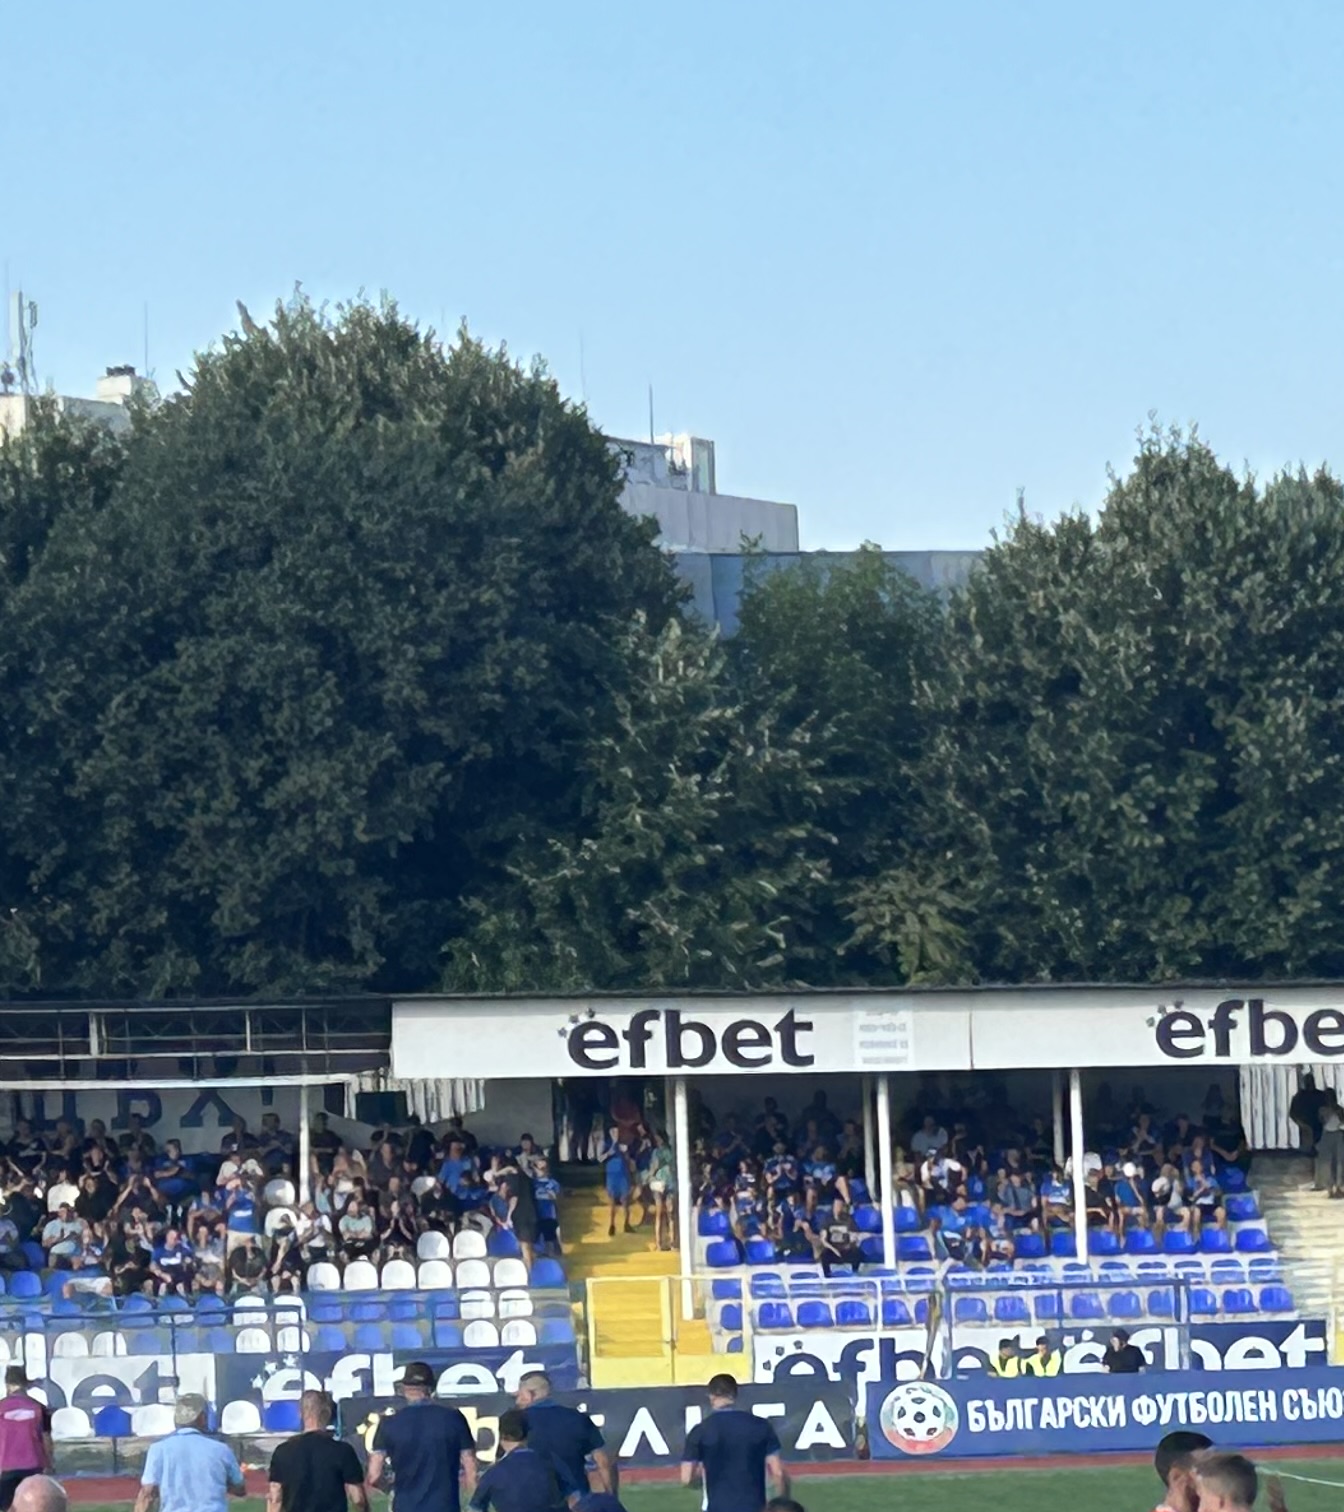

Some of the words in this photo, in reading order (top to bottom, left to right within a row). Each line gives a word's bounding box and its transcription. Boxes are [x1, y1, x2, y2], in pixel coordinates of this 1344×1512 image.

[617, 1400, 848, 1458] ЛА
[966, 1392, 1126, 1433] БЪЛГАРСКИ
[1131, 1386, 1277, 1428] ФУТБОЛЕН
